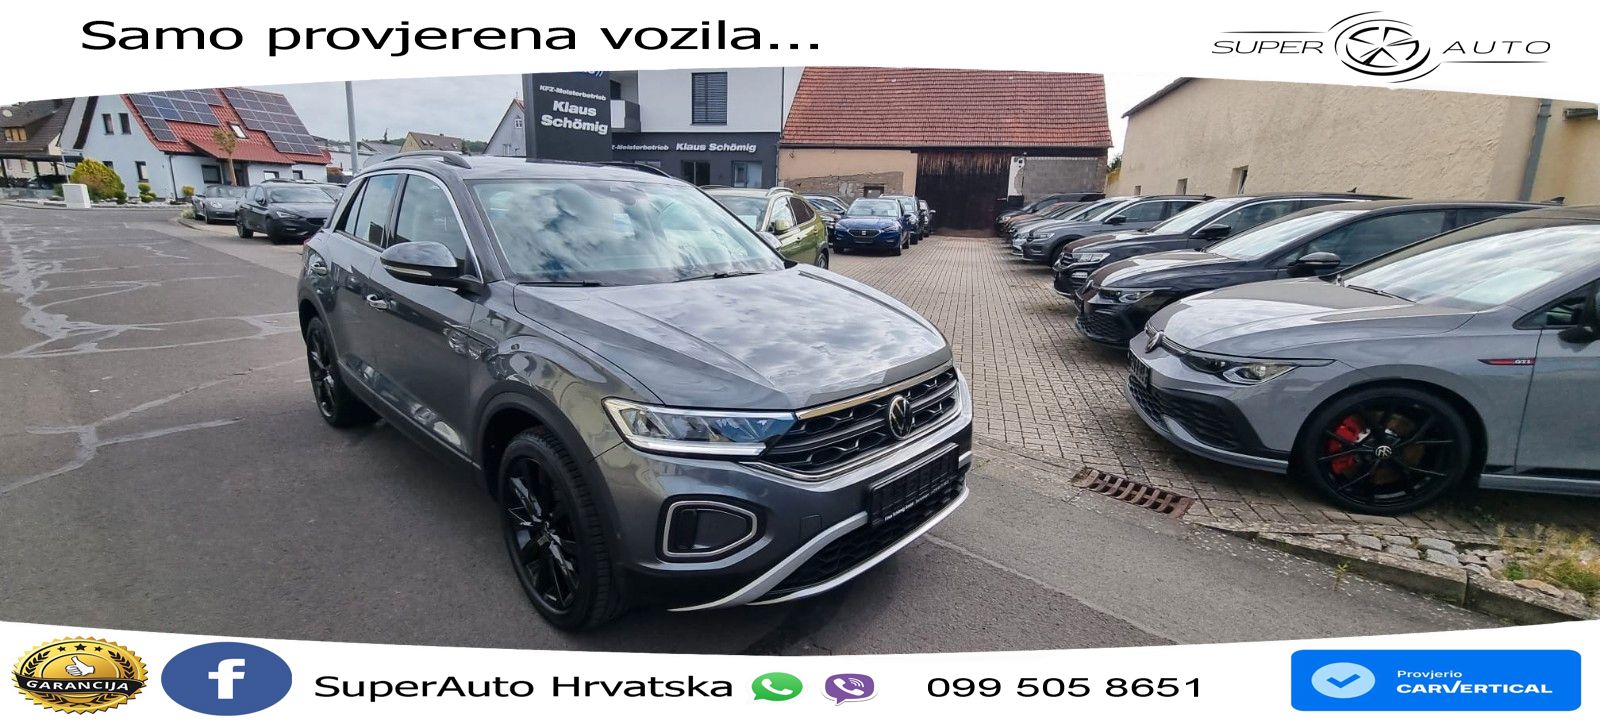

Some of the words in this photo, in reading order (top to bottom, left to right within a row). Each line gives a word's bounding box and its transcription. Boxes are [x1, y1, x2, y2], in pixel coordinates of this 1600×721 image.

[539, 84, 607, 101] KFZ-Meisterbetrieb
[552, 100, 597, 117] Klaus
[540, 114, 609, 135] Schömig
[676, 142, 707, 151] Klaus
[708, 142, 757, 153] Schömig
